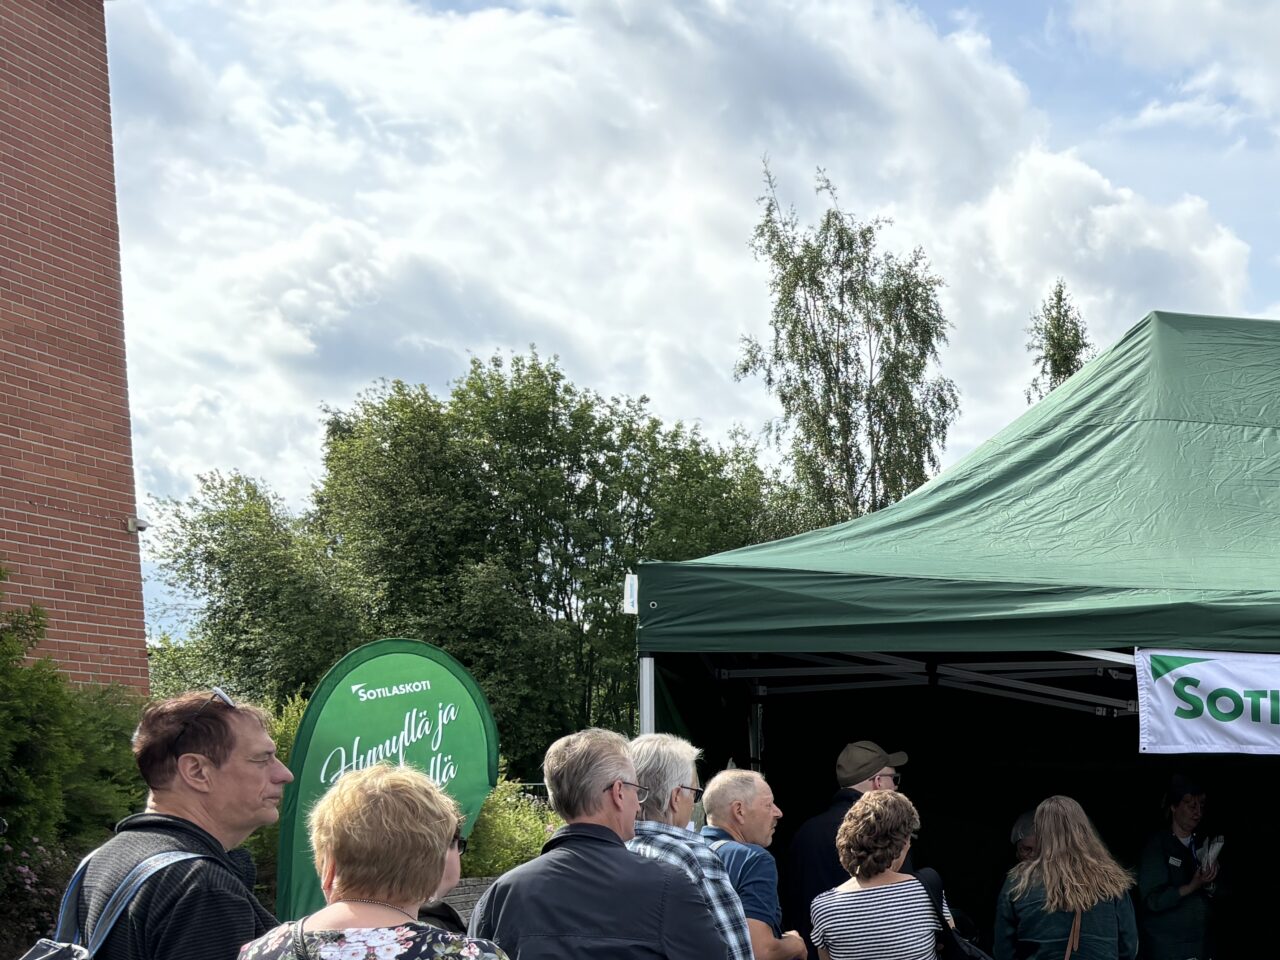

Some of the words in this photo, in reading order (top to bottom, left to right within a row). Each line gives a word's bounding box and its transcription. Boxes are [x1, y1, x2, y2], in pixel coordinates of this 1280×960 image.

[358, 680, 431, 702] SOTILASKOTI
[320, 708, 434, 783] Hymyllä
[431, 702, 460, 751] ja
